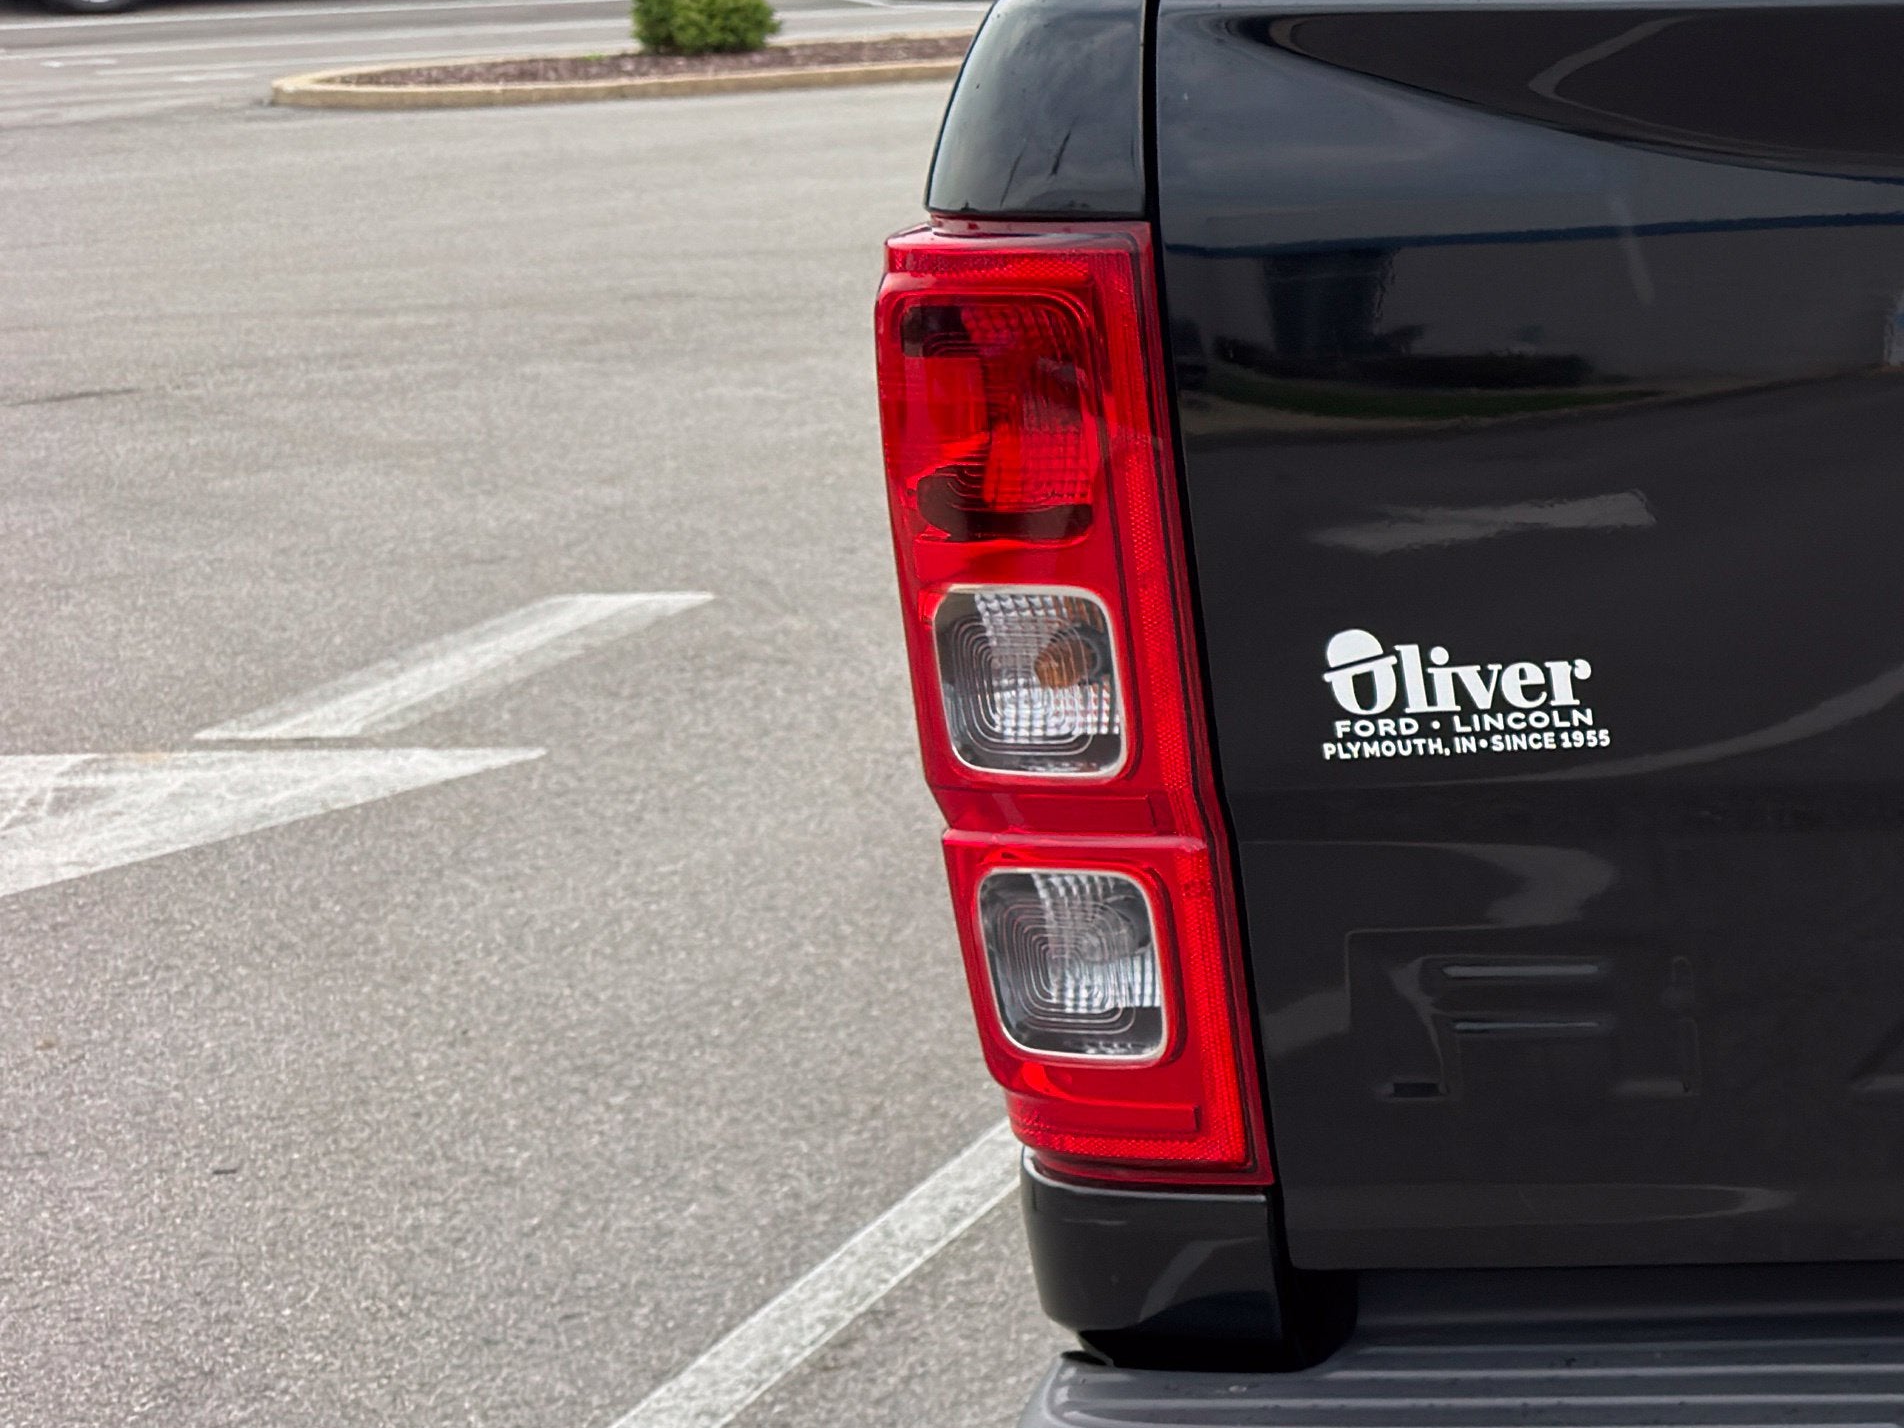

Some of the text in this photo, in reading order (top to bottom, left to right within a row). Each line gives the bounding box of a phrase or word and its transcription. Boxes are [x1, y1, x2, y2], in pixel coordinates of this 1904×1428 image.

[1323, 628, 1592, 715] Oliver
[1335, 708, 1594, 739] FORD LINCOLN
[1322, 737, 1450, 760] PLYMOUTH,
[1560, 729, 1611, 749] 1955
